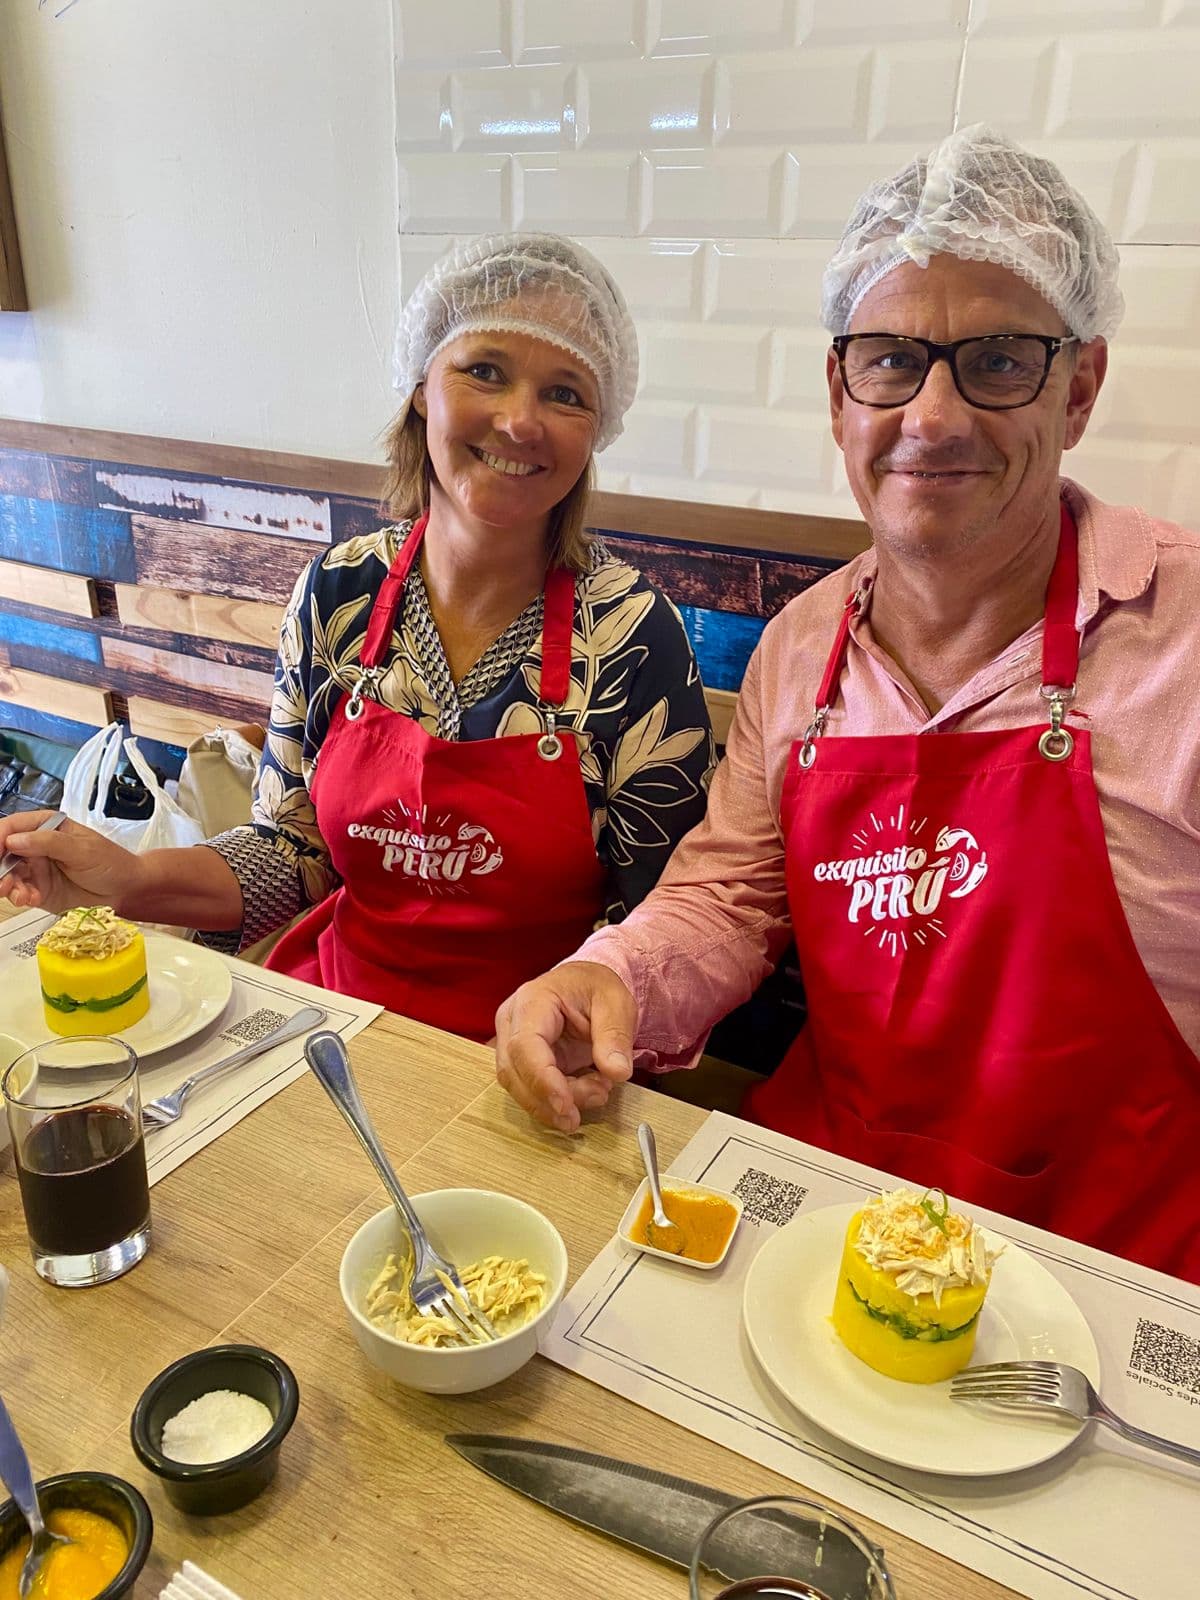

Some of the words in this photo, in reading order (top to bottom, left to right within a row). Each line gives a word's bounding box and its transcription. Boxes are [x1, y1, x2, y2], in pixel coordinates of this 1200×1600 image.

[347, 823, 451, 850] exquisito
[382, 844, 471, 882] PERÚ
[813, 845, 928, 886] exquisito
[848, 857, 952, 923] PERÚ
[1125, 1370, 1174, 1397] Sociales
[1176, 1391, 1200, 1405] des
